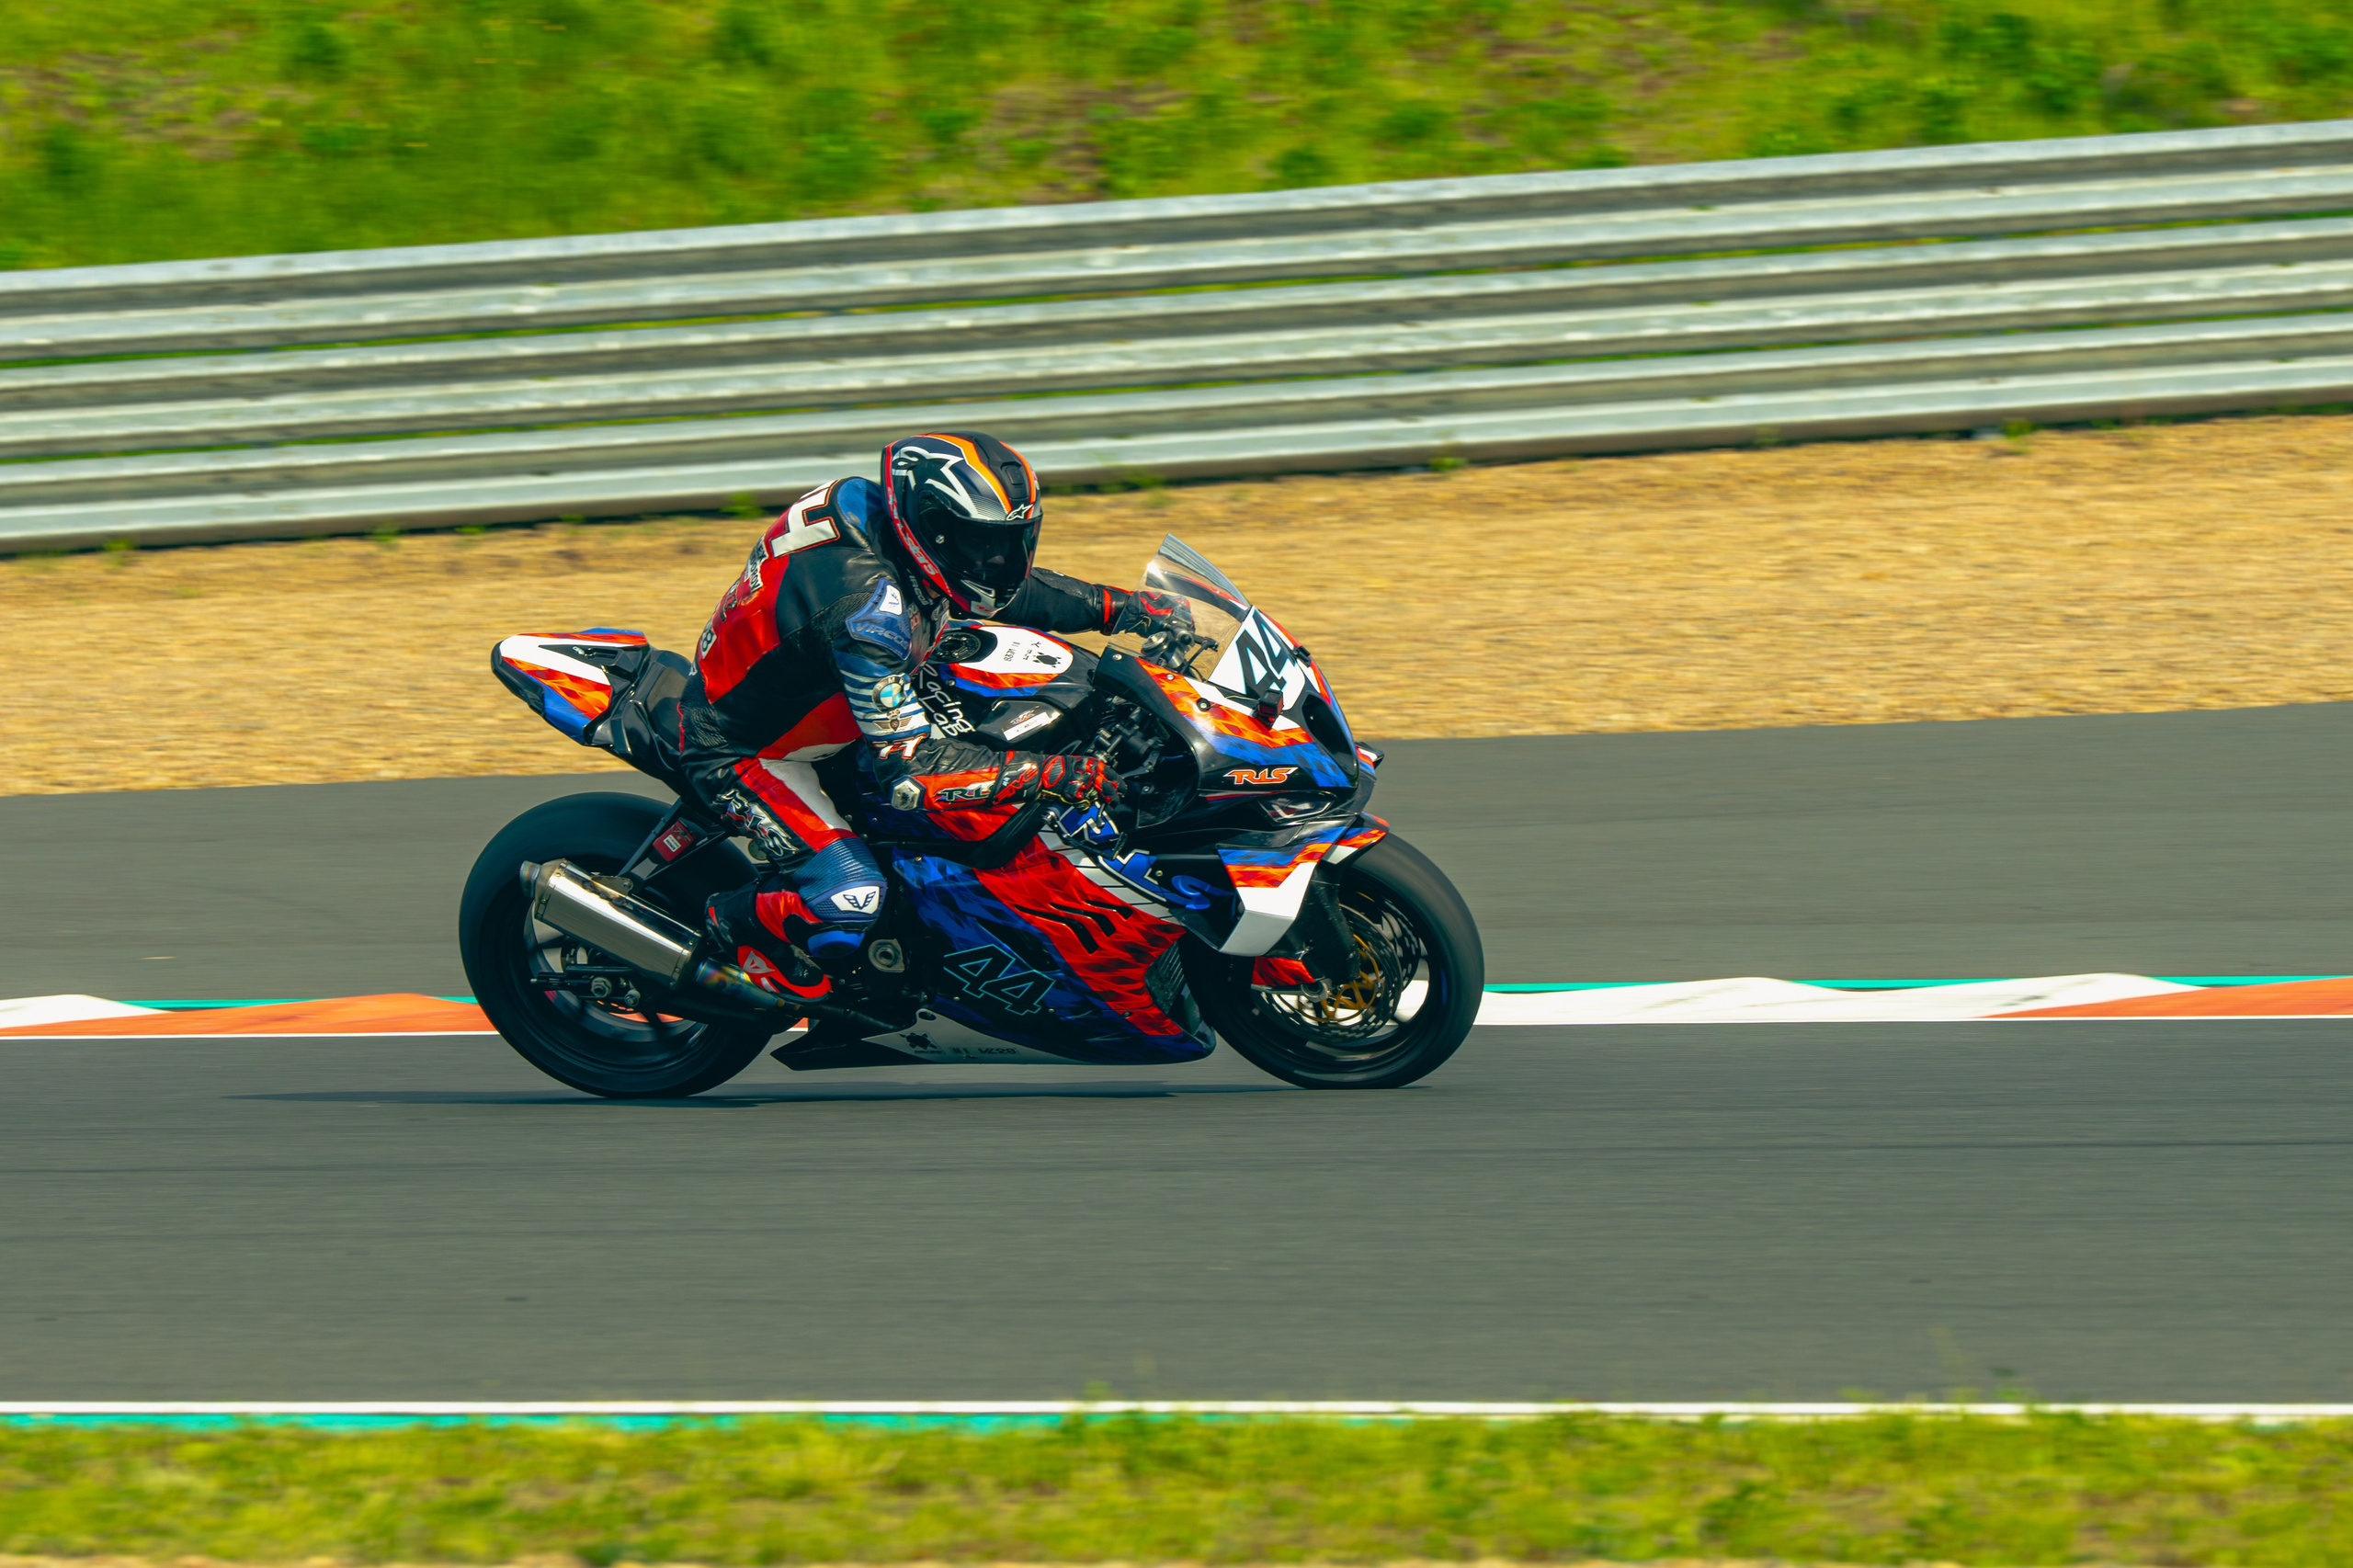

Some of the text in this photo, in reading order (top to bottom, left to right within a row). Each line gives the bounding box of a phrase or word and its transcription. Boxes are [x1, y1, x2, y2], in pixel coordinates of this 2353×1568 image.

[1235, 608, 1297, 696] 44
[920, 663, 977, 733] Racing
[943, 943, 1056, 1017] 44
